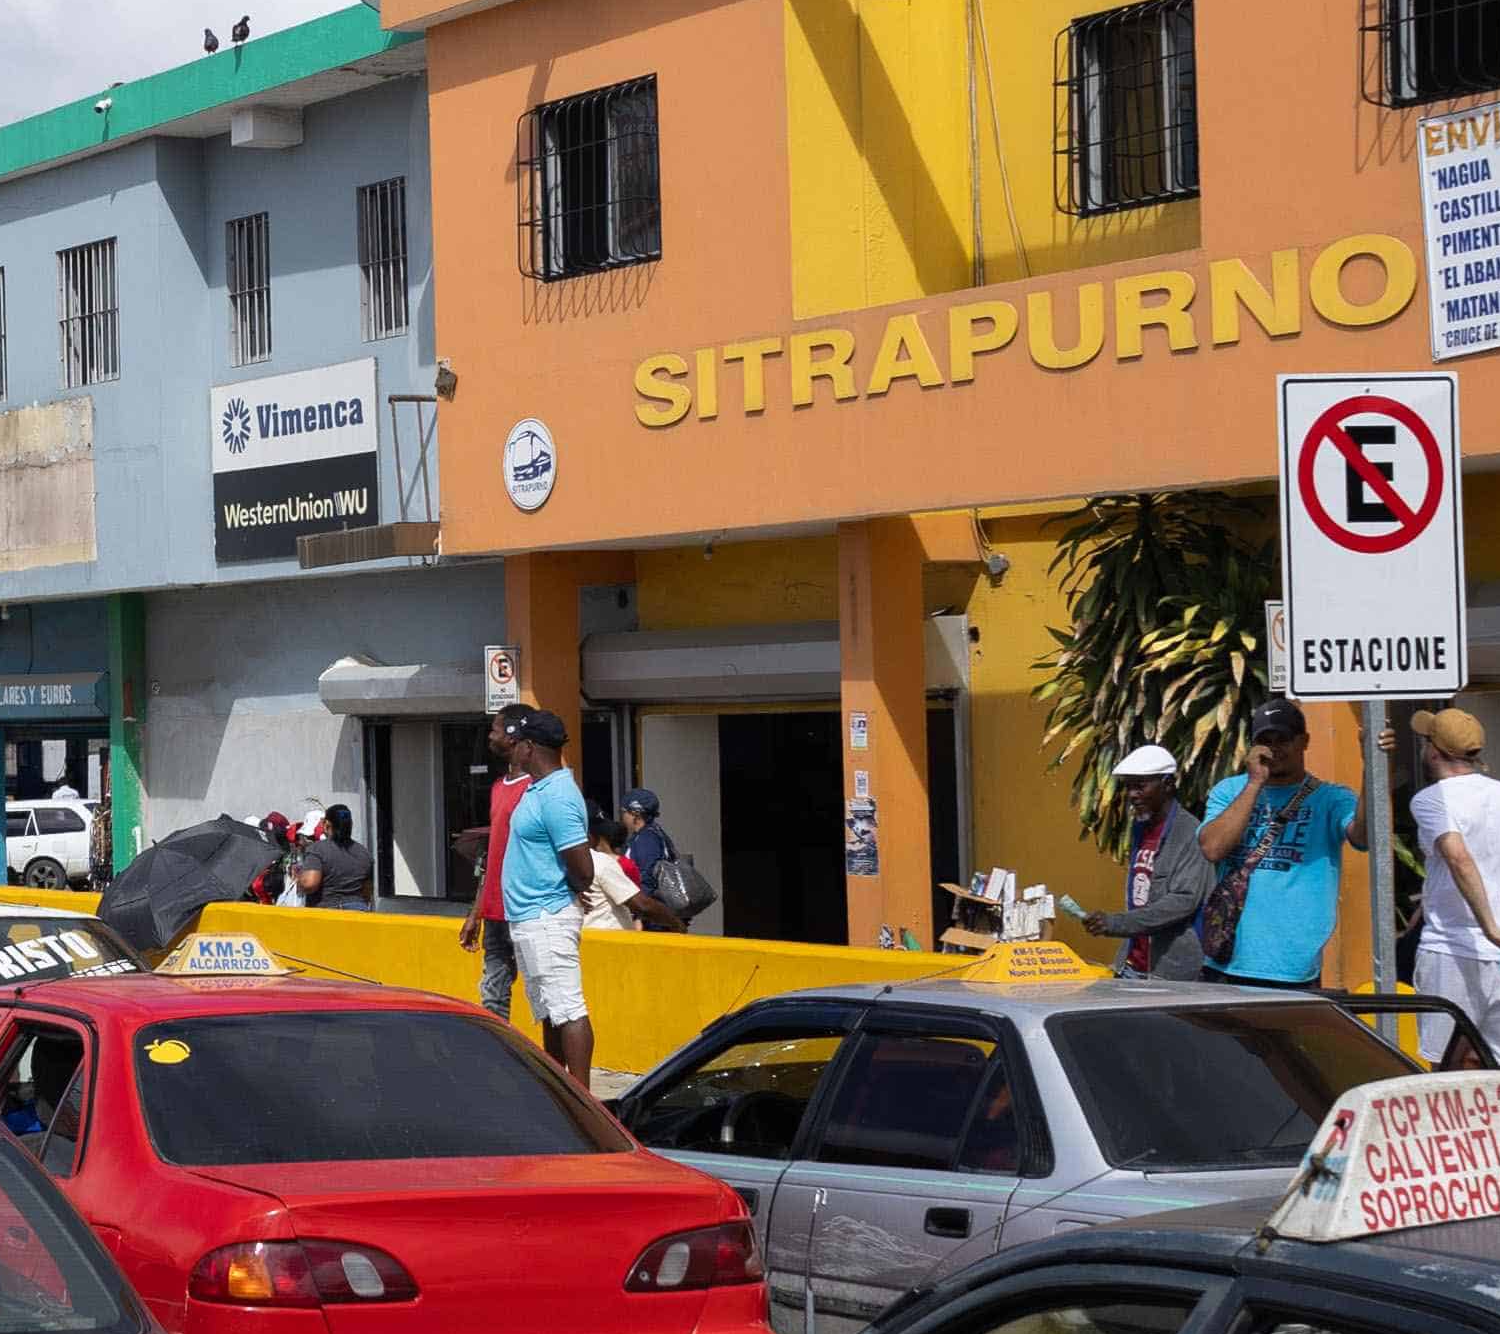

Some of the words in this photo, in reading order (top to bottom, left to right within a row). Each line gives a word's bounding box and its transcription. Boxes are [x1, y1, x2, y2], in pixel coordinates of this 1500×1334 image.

[633, 233, 1418, 428] SITRAPURNO
[1484, 322, 1498, 341] DE
[256, 398, 364, 439] Vimenca
[512, 480, 549, 495] SITRAPURNO
[1303, 636, 1447, 674] ESTACIONE
[26, 685, 36, 704] Y
[199, 940, 256, 958] KM-9
[188, 956, 271, 971] ALCARRIZOS
[1371, 1094, 1421, 1140] TCP
